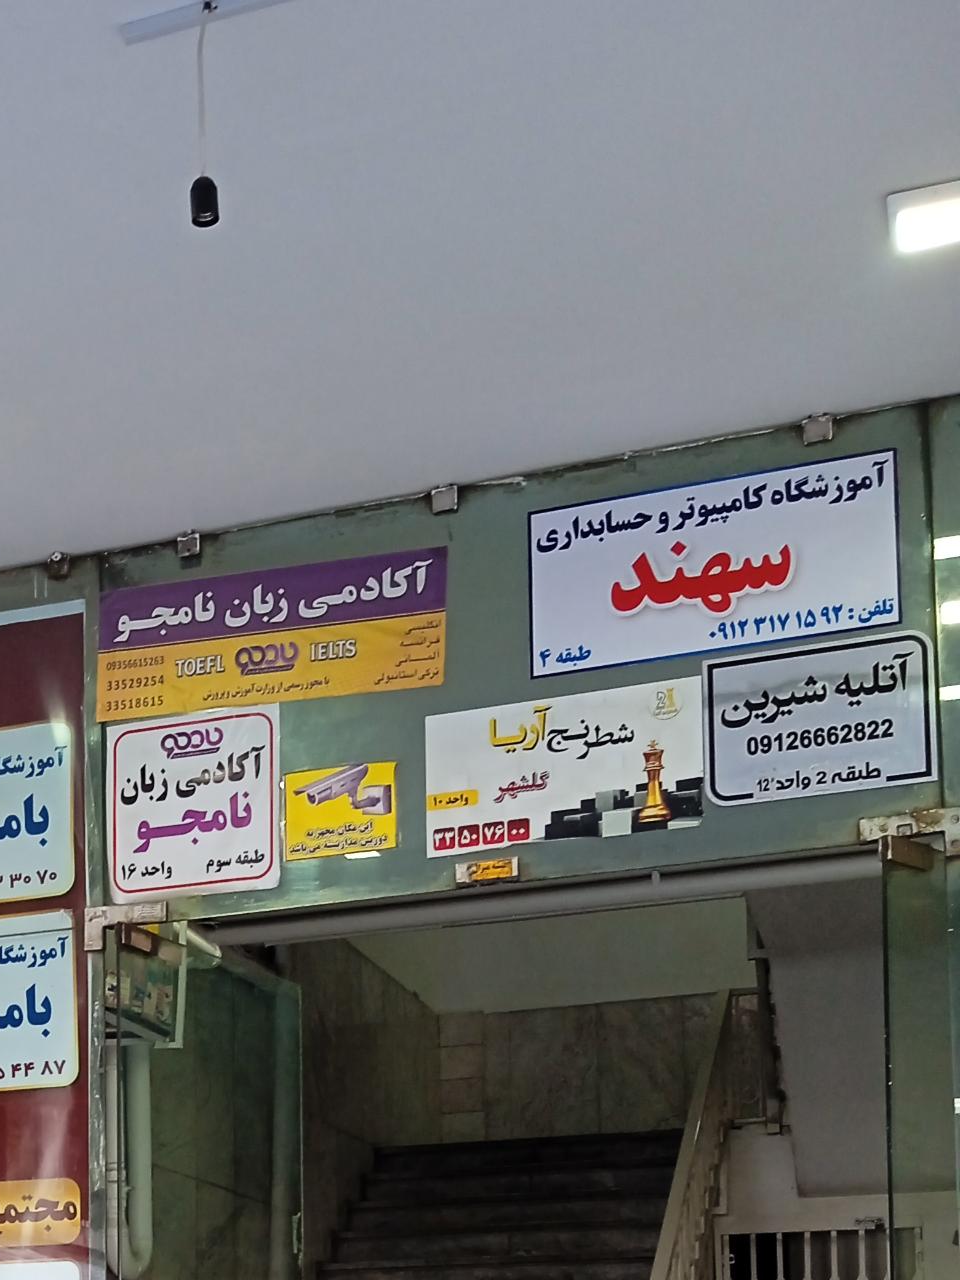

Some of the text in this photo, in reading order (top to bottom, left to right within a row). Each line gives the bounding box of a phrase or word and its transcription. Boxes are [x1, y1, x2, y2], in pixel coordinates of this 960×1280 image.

[537, 459, 889, 553] آموزشگاه کامپیوتر و حسابداری
[611, 541, 790, 612] سهند
[114, 559, 432, 642] آکادمی زبان نامجو
[175, 638, 357, 678] TOEFL IELTS
[556, 645, 591, 663] طبقه
[107, 675, 164, 691] 33529254
[721, 652, 914, 728] آتلیه شیرین
[106, 696, 163, 712] 33518615
[490, 706, 634, 759] شطرنج آریا
[747, 719, 893, 755] 09126662822
[121, 746, 266, 805] آکادمی زبان
[493, 771, 549, 803] گلشهر
[776, 762, 881, 790] طبقه 2 واحد
[446, 794, 468, 805] واحد
[133, 792, 251, 854] نامجو
[141, 861, 172, 879] واحد
[206, 858, 231, 873] سوم
[235, 849, 265, 865] طبقه
